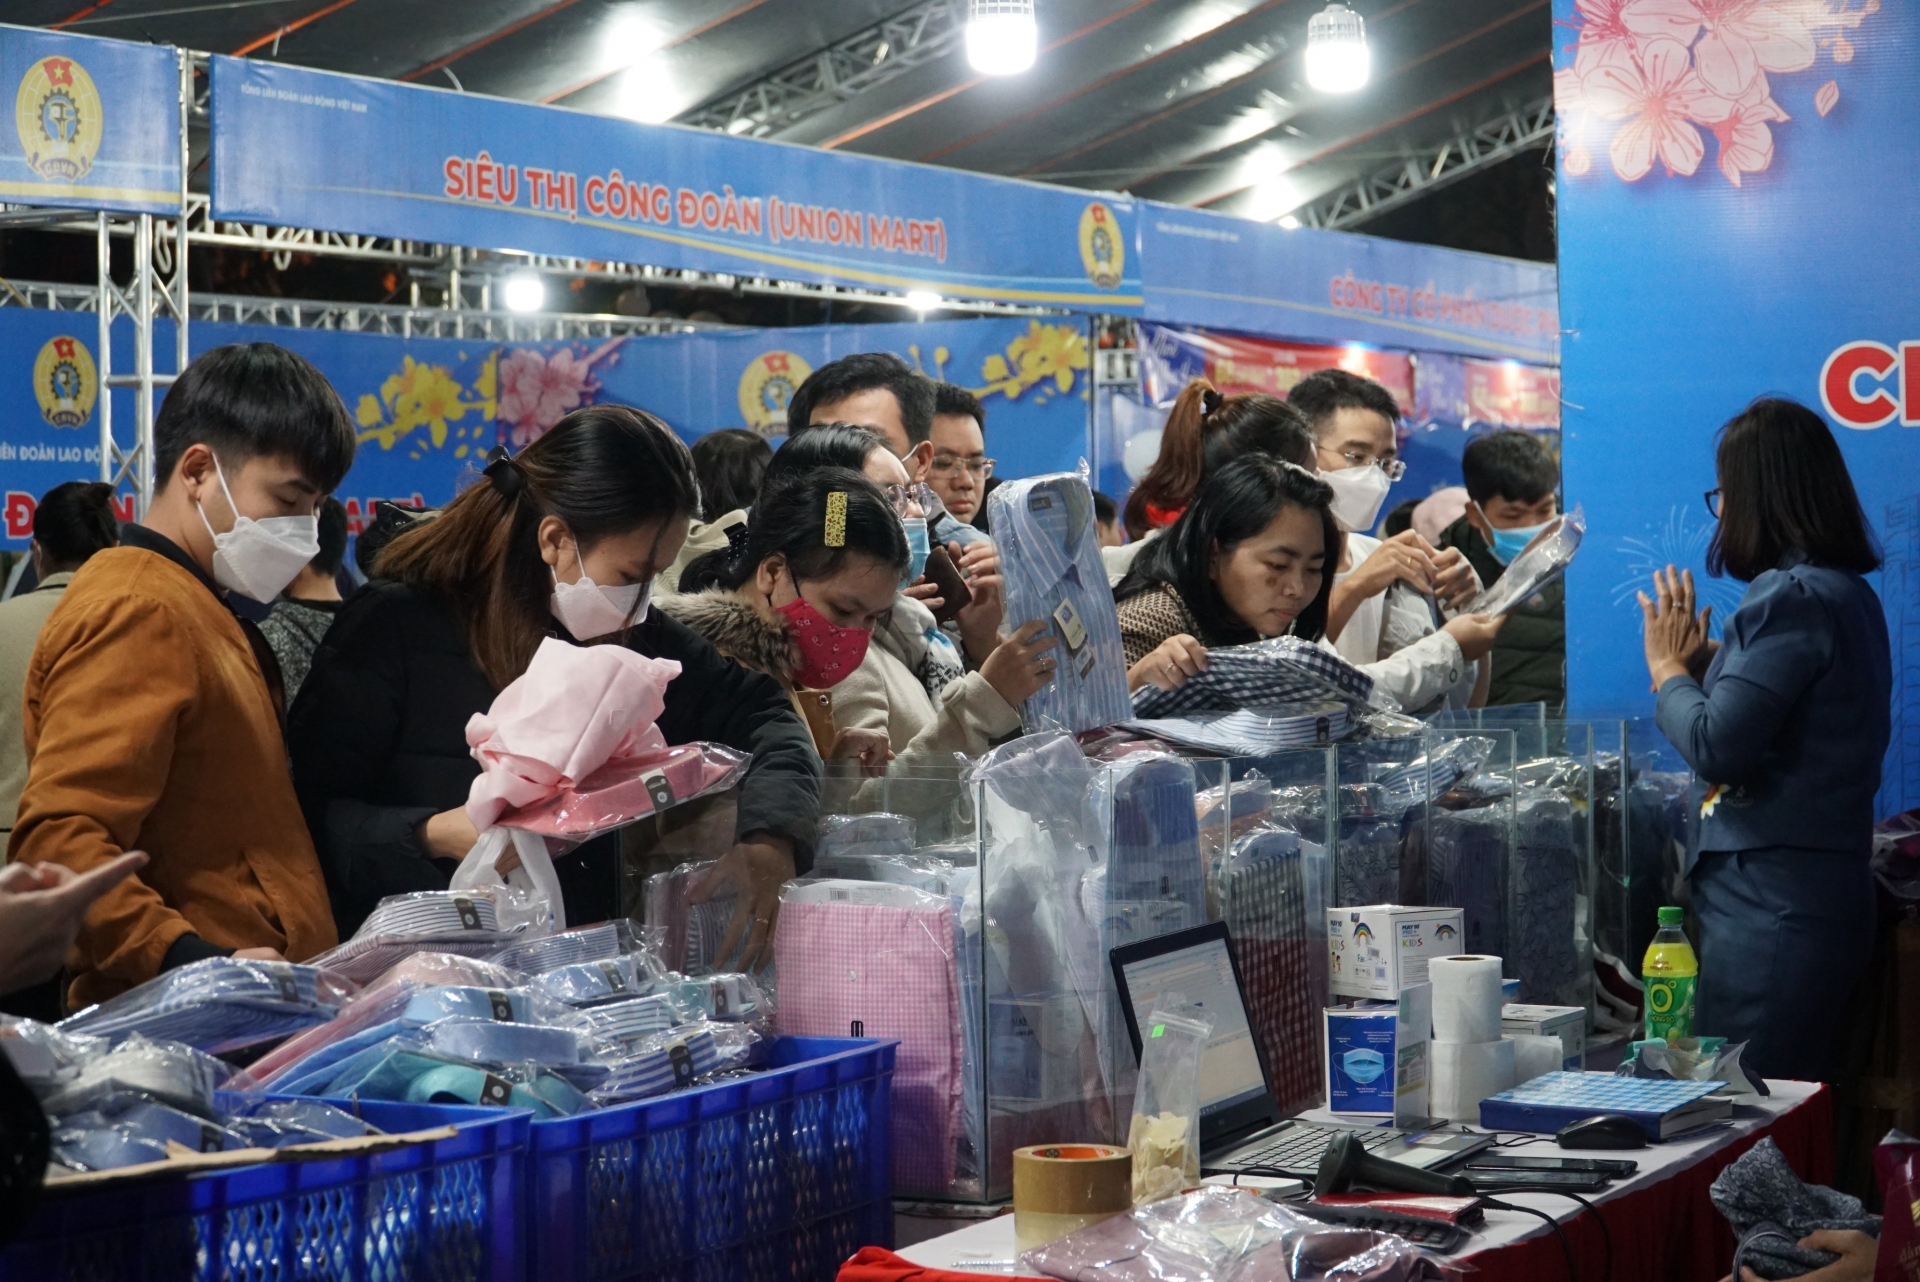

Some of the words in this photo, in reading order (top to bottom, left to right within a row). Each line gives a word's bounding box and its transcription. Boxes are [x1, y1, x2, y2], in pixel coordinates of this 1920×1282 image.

[445, 152, 517, 204] SIÊU
[525, 168, 576, 222] THỊ
[586, 170, 671, 222] CÔNG
[677, 185, 761, 235] ĐOÀN
[769, 197, 863, 247] (UNION
[868, 214, 947, 262] MART)
[1331, 270, 1382, 313] CÔNG
[1386, 284, 1409, 317] TY
[1819, 340, 1920, 430] C
[19, 443, 56, 461] ĐOÀN
[58, 446, 82, 463] LAO
[1331, 940, 1345, 951] KIDS
[1402, 938, 1423, 948] KIDS
